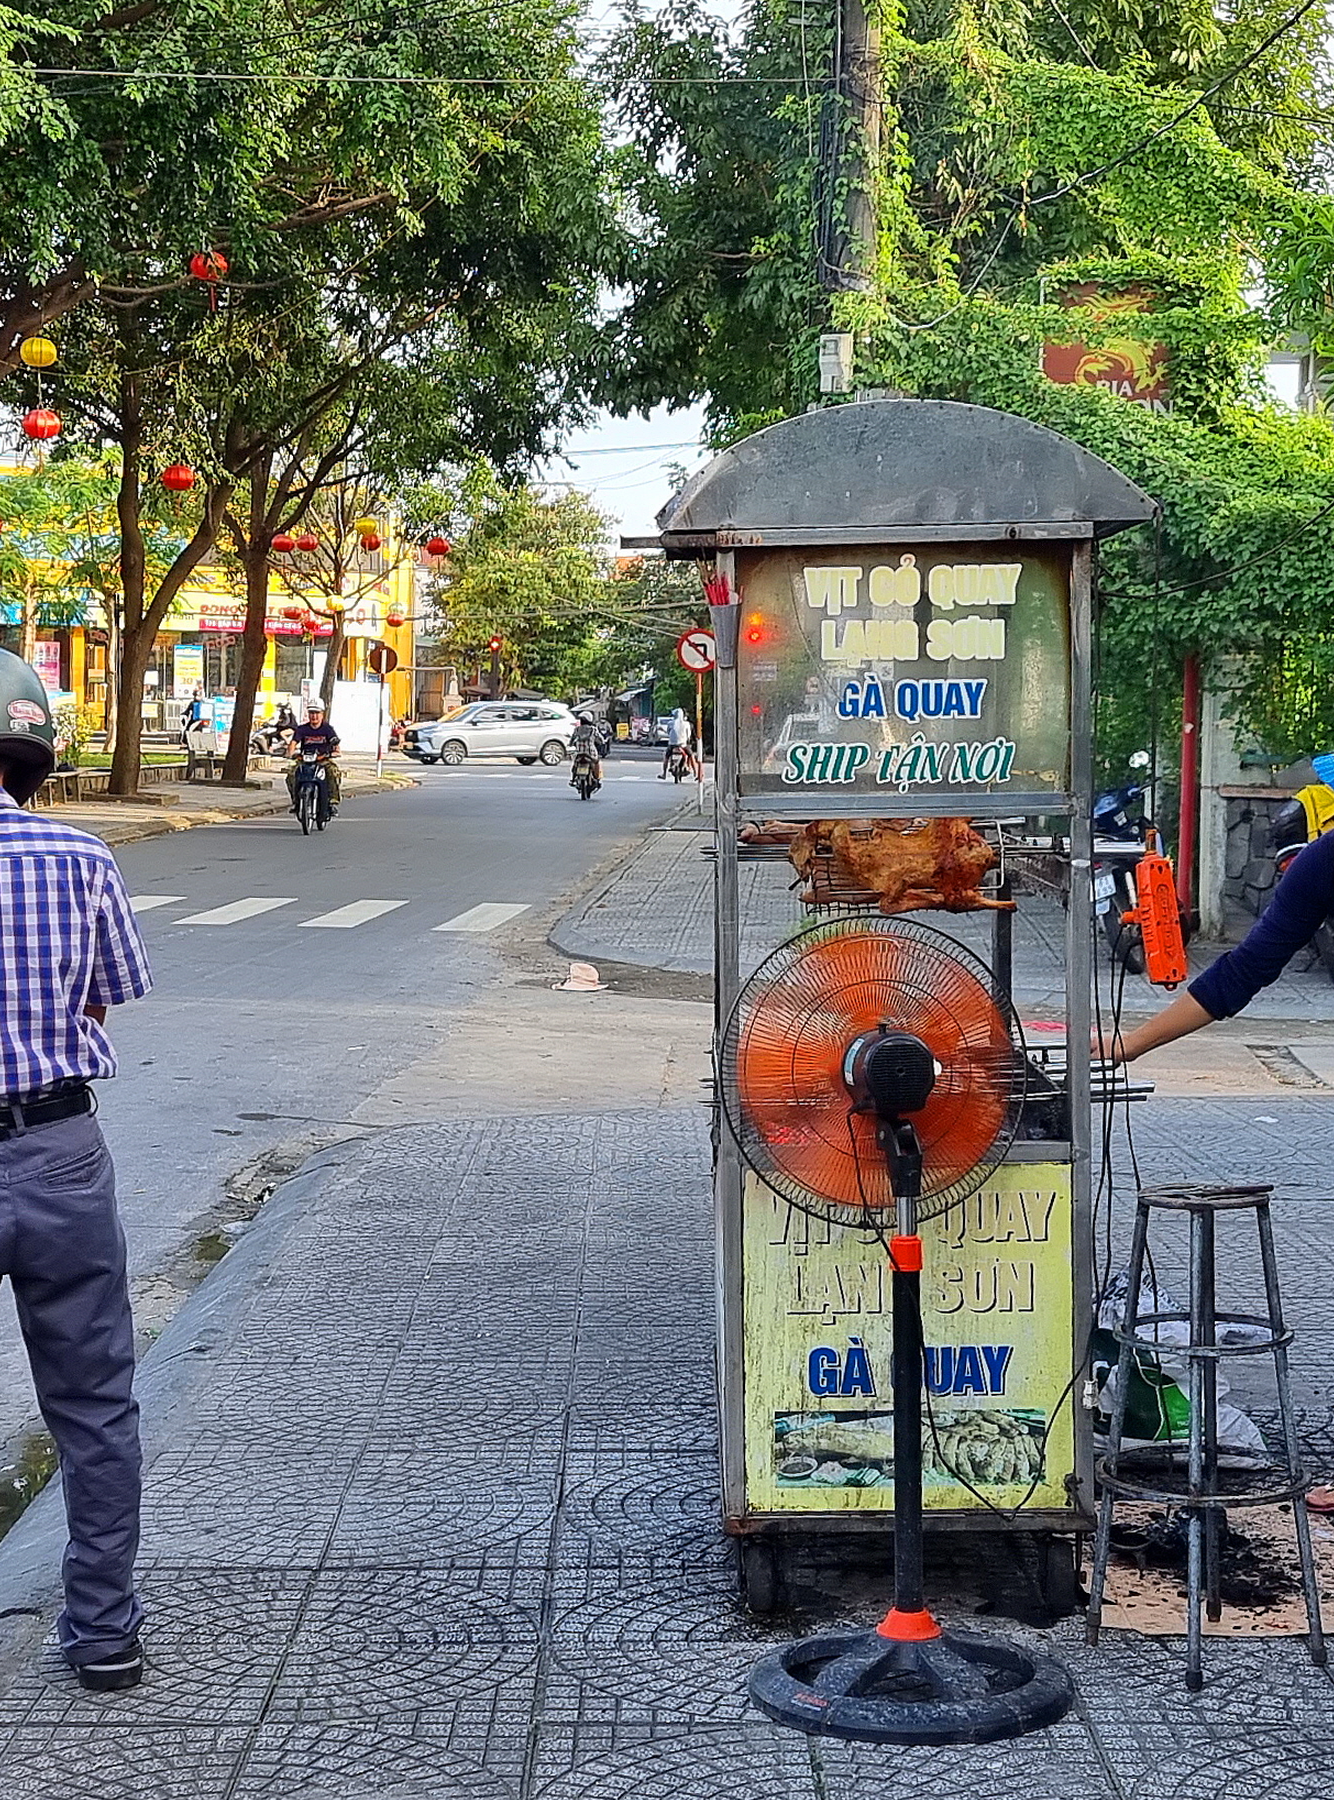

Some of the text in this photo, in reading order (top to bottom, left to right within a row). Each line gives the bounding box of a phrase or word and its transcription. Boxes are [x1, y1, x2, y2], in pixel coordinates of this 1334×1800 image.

[803, 567, 863, 616] VỊT
[928, 563, 1023, 611] QUAY
[821, 614, 1006, 668] LẠNG SƠN
[837, 672, 987, 723] GÀ QUAY
[782, 732, 1016, 794] SHIP TẬN NƠI
[933, 1190, 1057, 1250] QUAY
[785, 1264, 895, 1326] LẠN
[808, 1336, 1014, 1399] GÀ UAY
